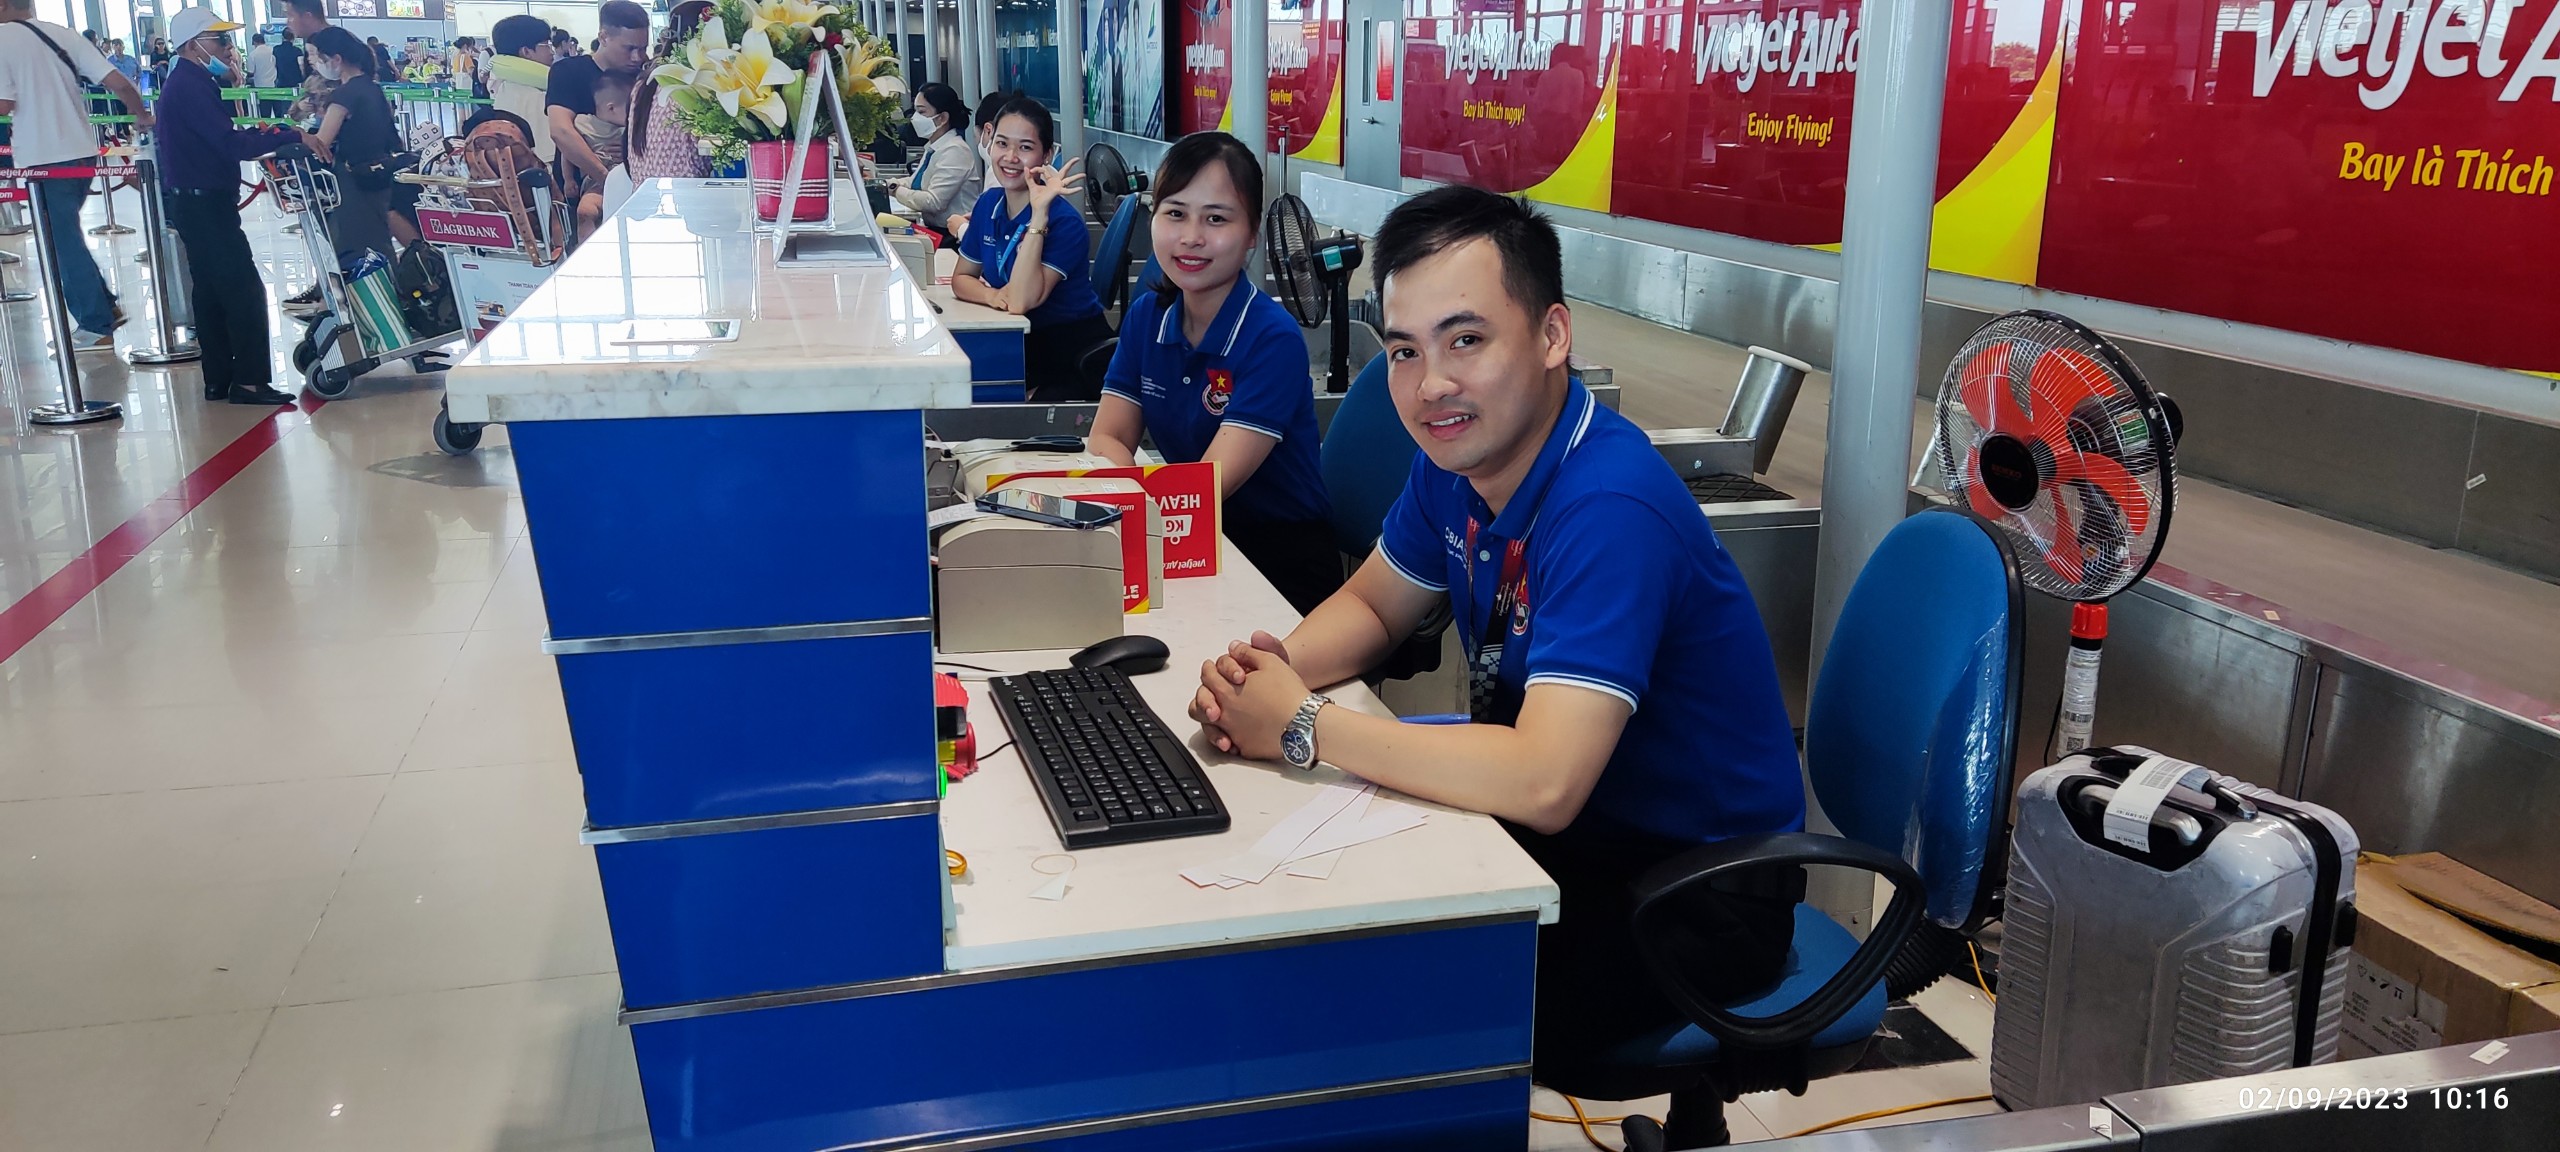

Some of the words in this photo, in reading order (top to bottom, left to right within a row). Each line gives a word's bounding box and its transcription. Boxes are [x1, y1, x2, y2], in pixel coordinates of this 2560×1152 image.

[1463, 100, 1476, 123] Bay
[1477, 100, 1484, 119] là
[1485, 101, 1503, 120] Thích
[1504, 104, 1526, 125] ngay!
[1747, 112, 1784, 143] Enjoy
[1786, 113, 1834, 148] Flying!
[2339, 142, 2405, 191] Bay
[2411, 145, 2445, 186] là
[2455, 149, 2554, 195] Thích
[443, 223, 500, 239] AGRIBANK
[1152, 493, 1201, 510] HEAV
[1165, 520, 1184, 532] KG
